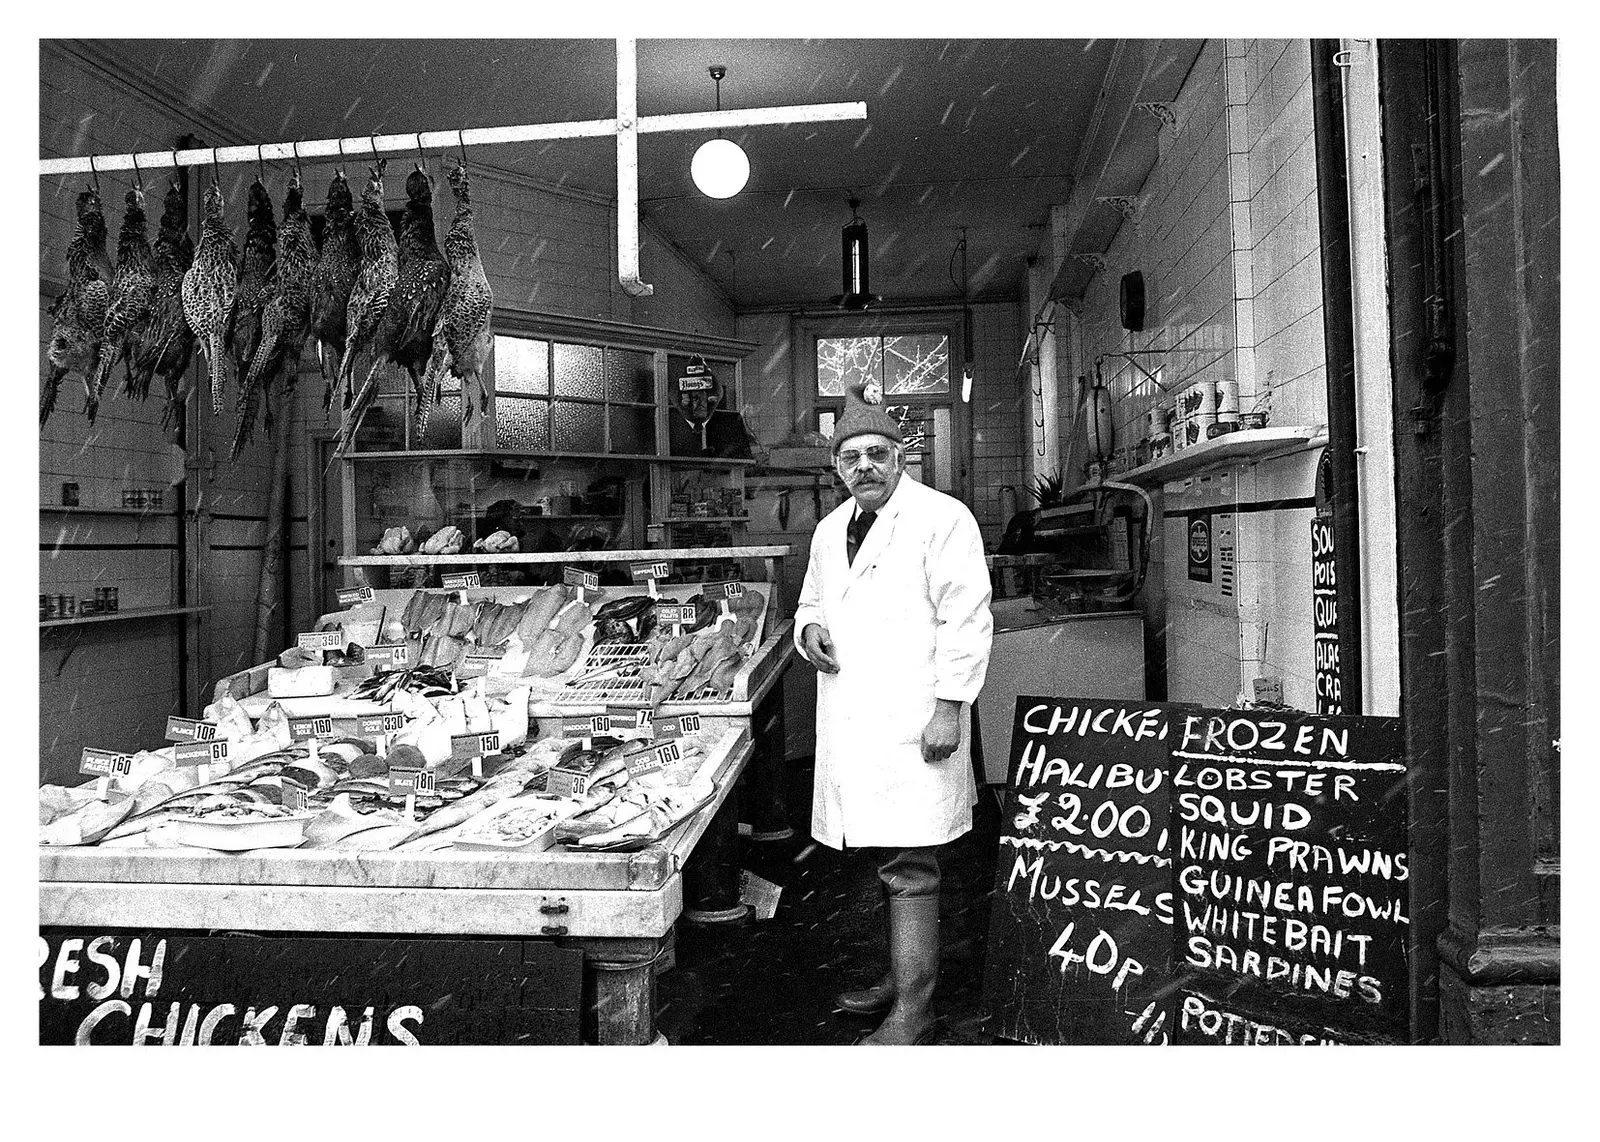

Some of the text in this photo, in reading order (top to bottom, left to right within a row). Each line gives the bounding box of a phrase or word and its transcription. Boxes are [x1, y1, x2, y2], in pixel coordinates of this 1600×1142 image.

[464, 575, 479, 586] 120
[584, 574, 597, 586] 160
[725, 583, 742, 595] 130
[360, 587, 372, 599] 90
[322, 634, 340, 646] 390
[394, 648, 406, 660] 44
[314, 719, 332, 734] 160
[384, 716, 403, 731] 330
[592, 717, 609, 732] 160
[680, 716, 700, 732] 160
[1024, 704, 1168, 742] CHICKE
[481, 736, 499, 751] 150
[1181, 716, 1348, 756] FROZEN
[213, 743, 228, 758] 60
[657, 744, 680, 764] 160
[112, 756, 131, 775] 160
[1016, 740, 1169, 794] HALIBU
[573, 777, 585, 794] 36
[1174, 764, 1359, 801] LOBSTER
[1180, 793, 1312, 830] SQUID
[1181, 825, 1252, 861] KING
[1267, 837, 1409, 880] PRAWNS
[1007, 855, 1174, 924] MUSSELS
[1180, 865, 1410, 924] GUINEA FOWL
[1184, 900, 1372, 966] WHITEBAIT
[1186, 936, 1382, 1003] SARDINES
[76, 1000, 424, 1046] CHICKENS
